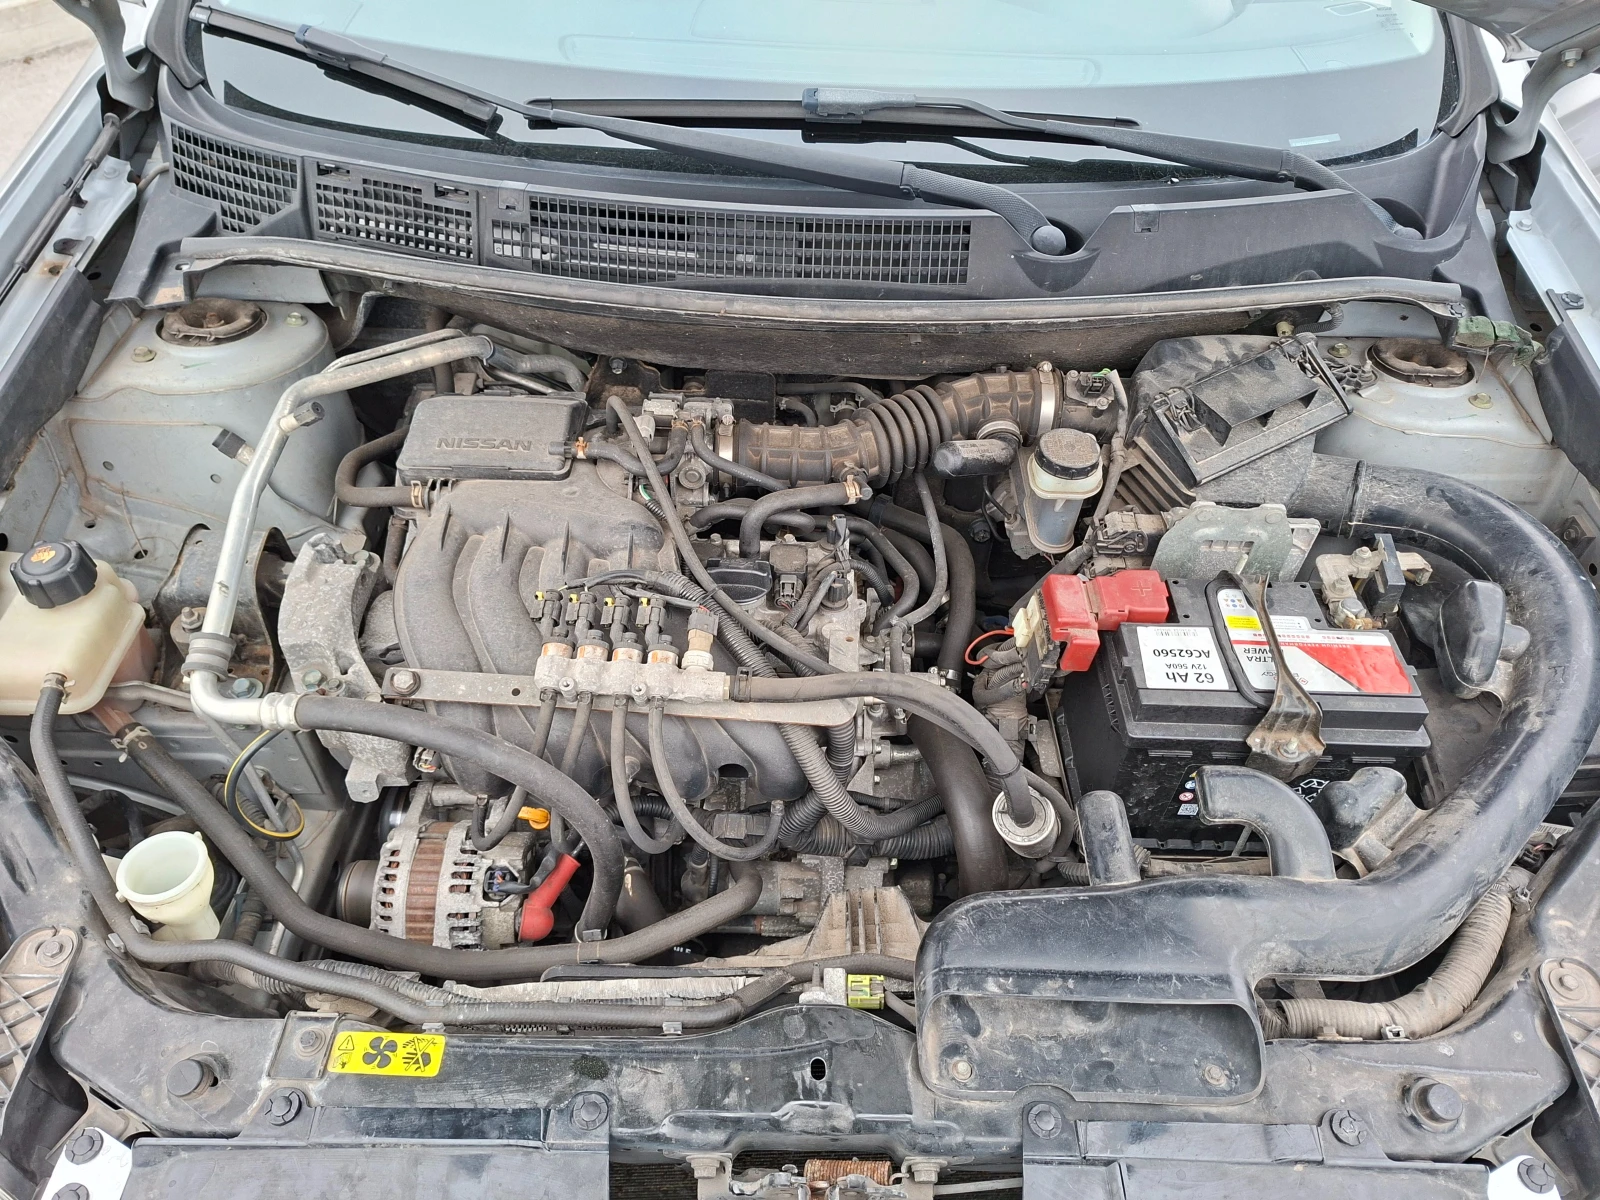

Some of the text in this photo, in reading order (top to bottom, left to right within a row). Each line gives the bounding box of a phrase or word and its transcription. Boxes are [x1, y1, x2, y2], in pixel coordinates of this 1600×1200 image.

[436, 437, 533, 452] NISSAN
[1152, 648, 1210, 659] AC62560
[1246, 655, 1273, 663] LTRA
[1165, 671, 1214, 684] 62 Ah
